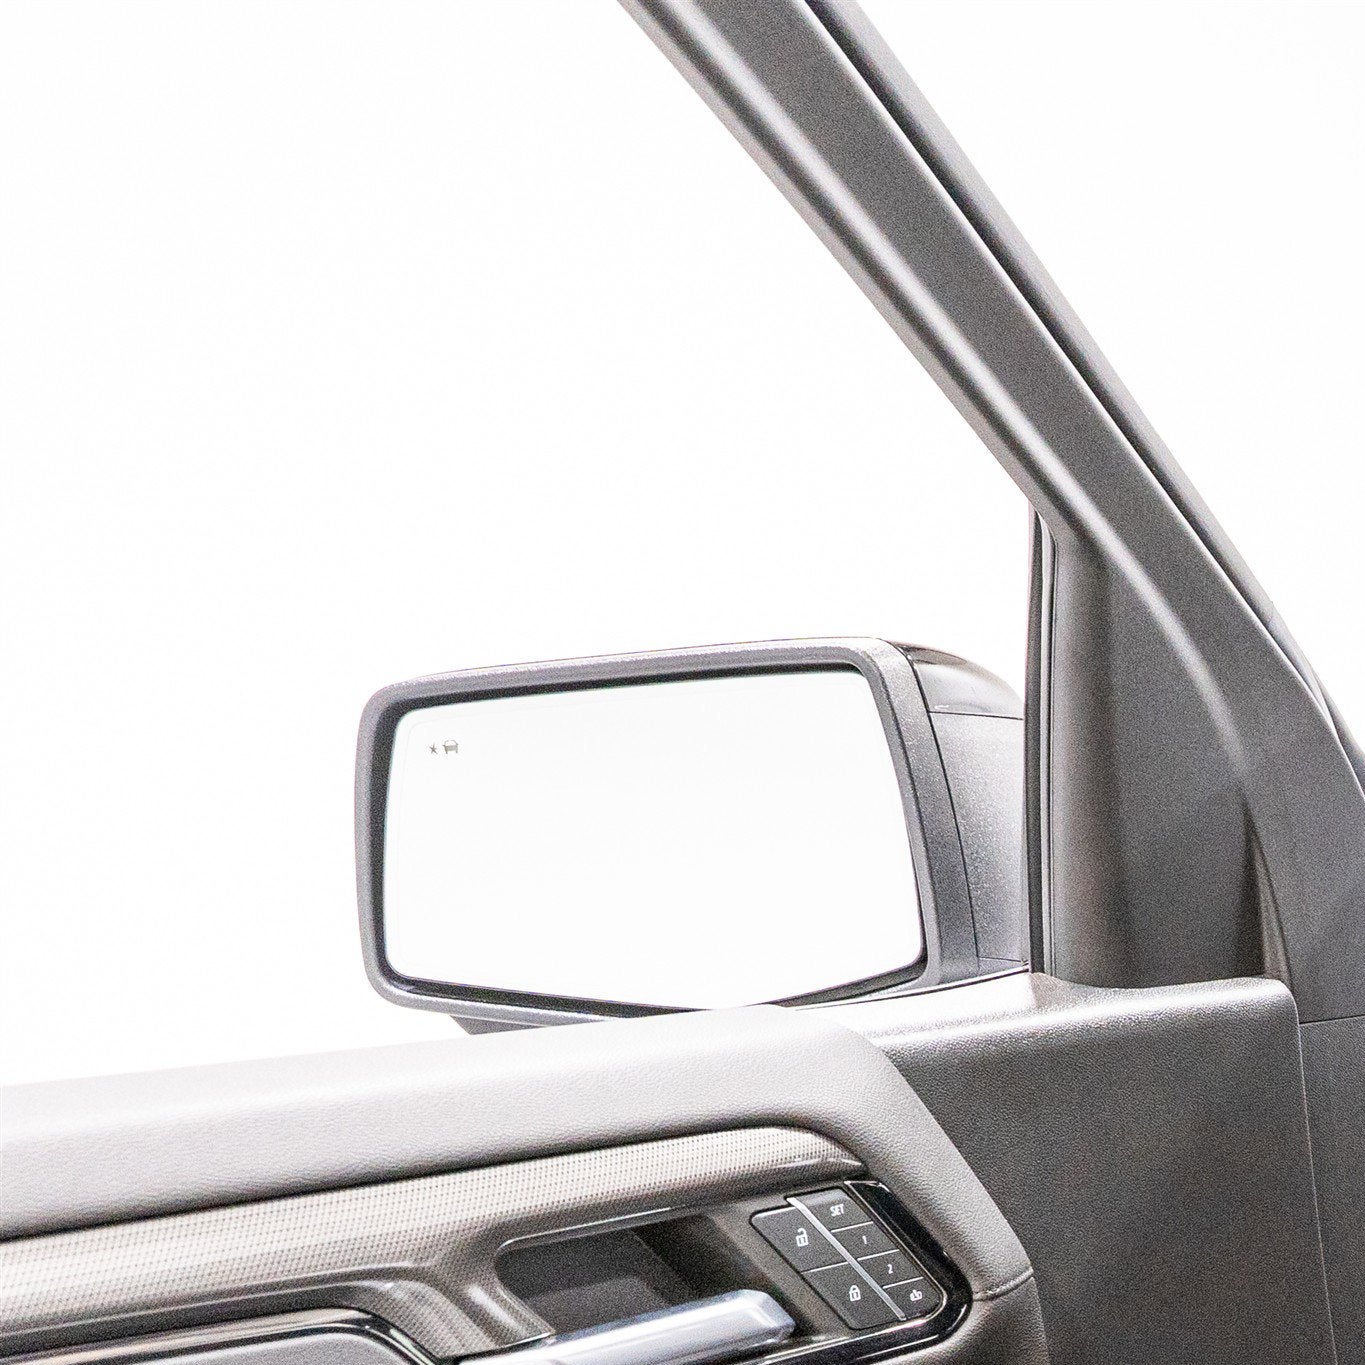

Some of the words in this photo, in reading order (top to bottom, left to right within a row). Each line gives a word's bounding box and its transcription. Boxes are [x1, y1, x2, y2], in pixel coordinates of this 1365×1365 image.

[829, 1203, 845, 1217] SET
[862, 1235, 867, 1245] 1
[887, 1264, 893, 1274] 2
